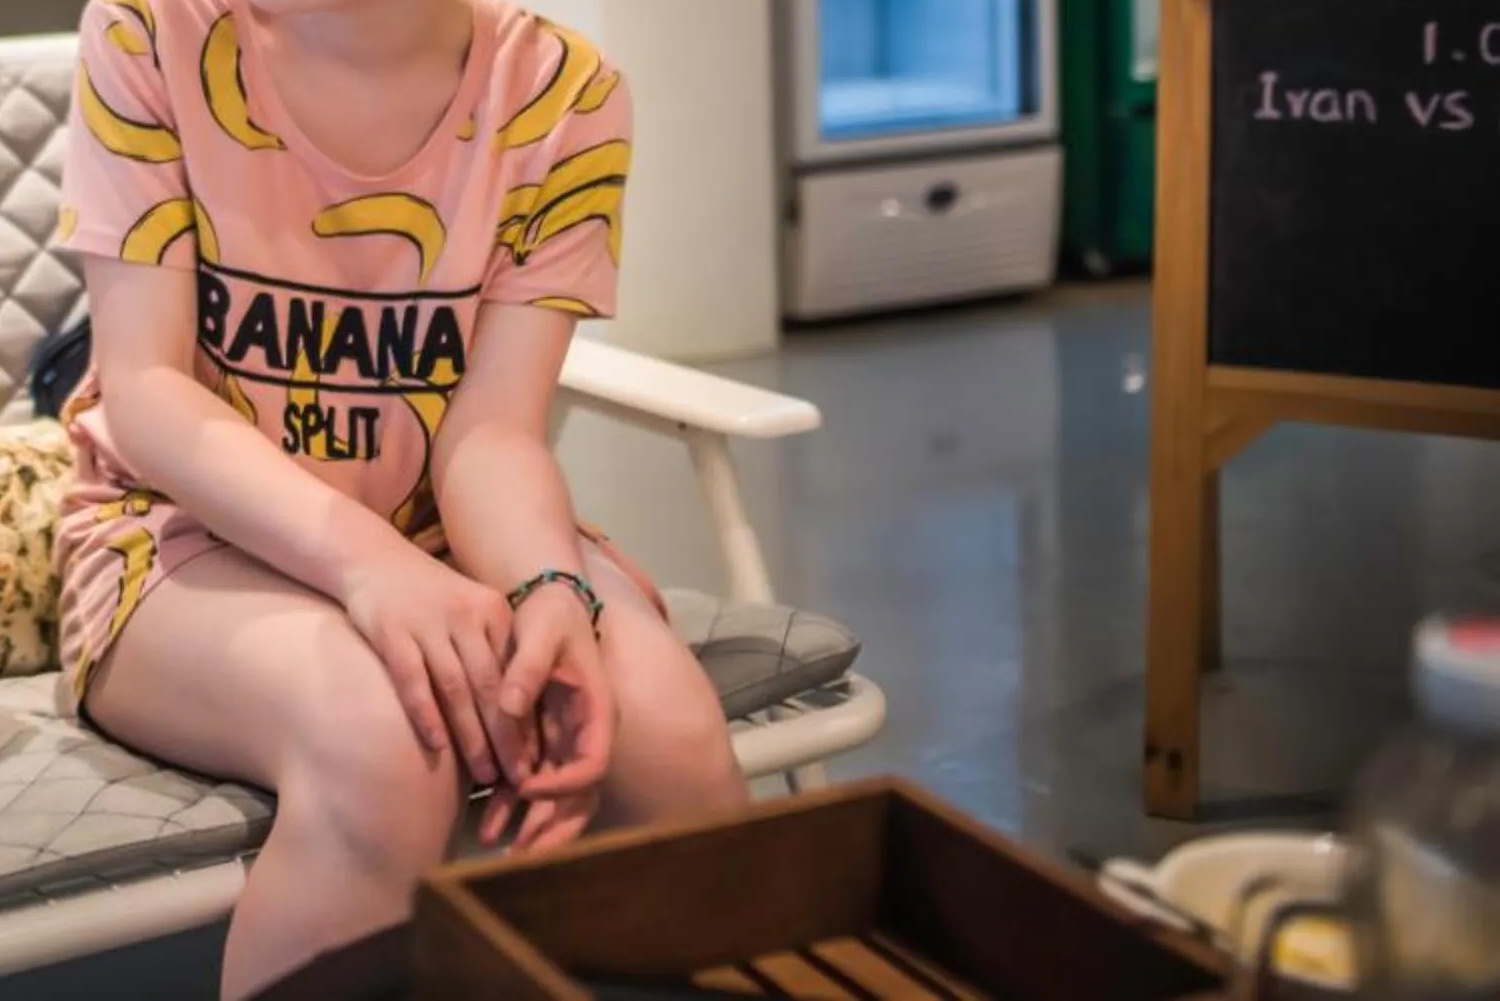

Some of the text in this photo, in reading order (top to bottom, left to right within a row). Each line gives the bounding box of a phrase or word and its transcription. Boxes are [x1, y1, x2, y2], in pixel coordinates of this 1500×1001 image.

[1253, 69, 1475, 130] Iran vs
[196, 270, 467, 380] BANANA
[281, 404, 381, 461] SPLIT
